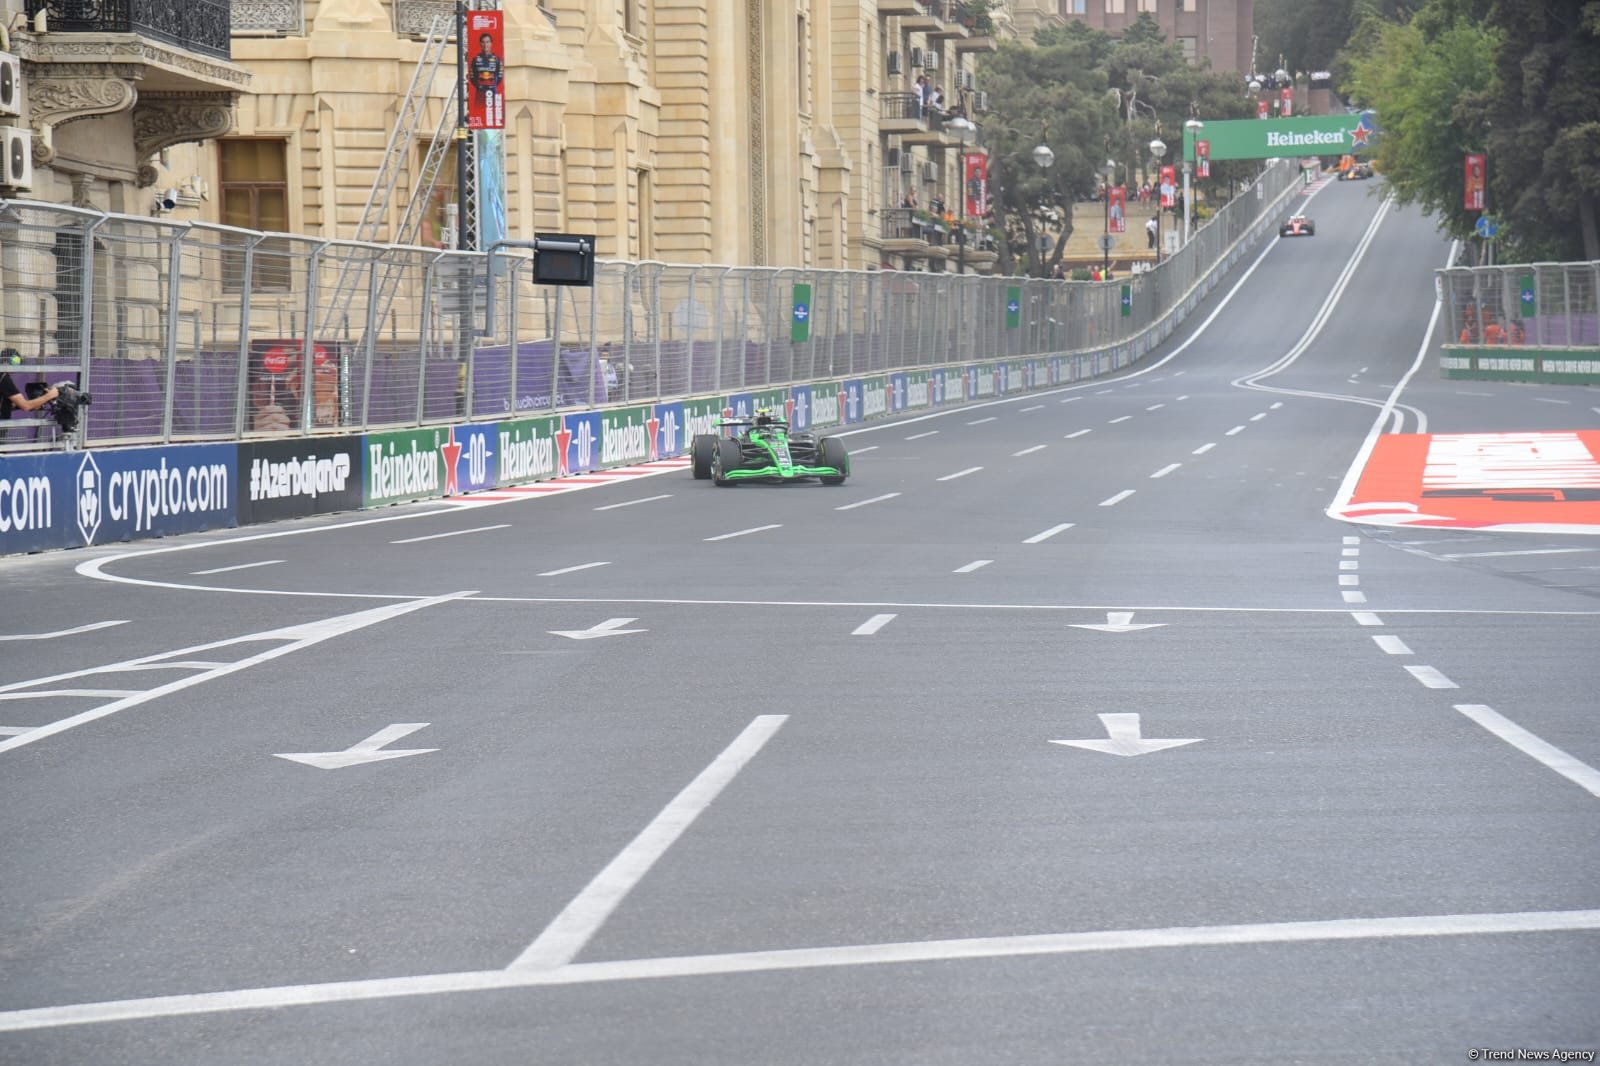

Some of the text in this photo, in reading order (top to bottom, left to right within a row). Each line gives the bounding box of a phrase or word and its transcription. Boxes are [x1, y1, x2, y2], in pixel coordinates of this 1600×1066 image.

[1267, 130, 1344, 146] Heineken
[499, 427, 553, 481] Heineken
[602, 415, 646, 464] Heineken
[108, 457, 228, 532] crypto.com
[249, 453, 351, 501] #AzerbaijanGP
[369, 439, 439, 499] Heineken
